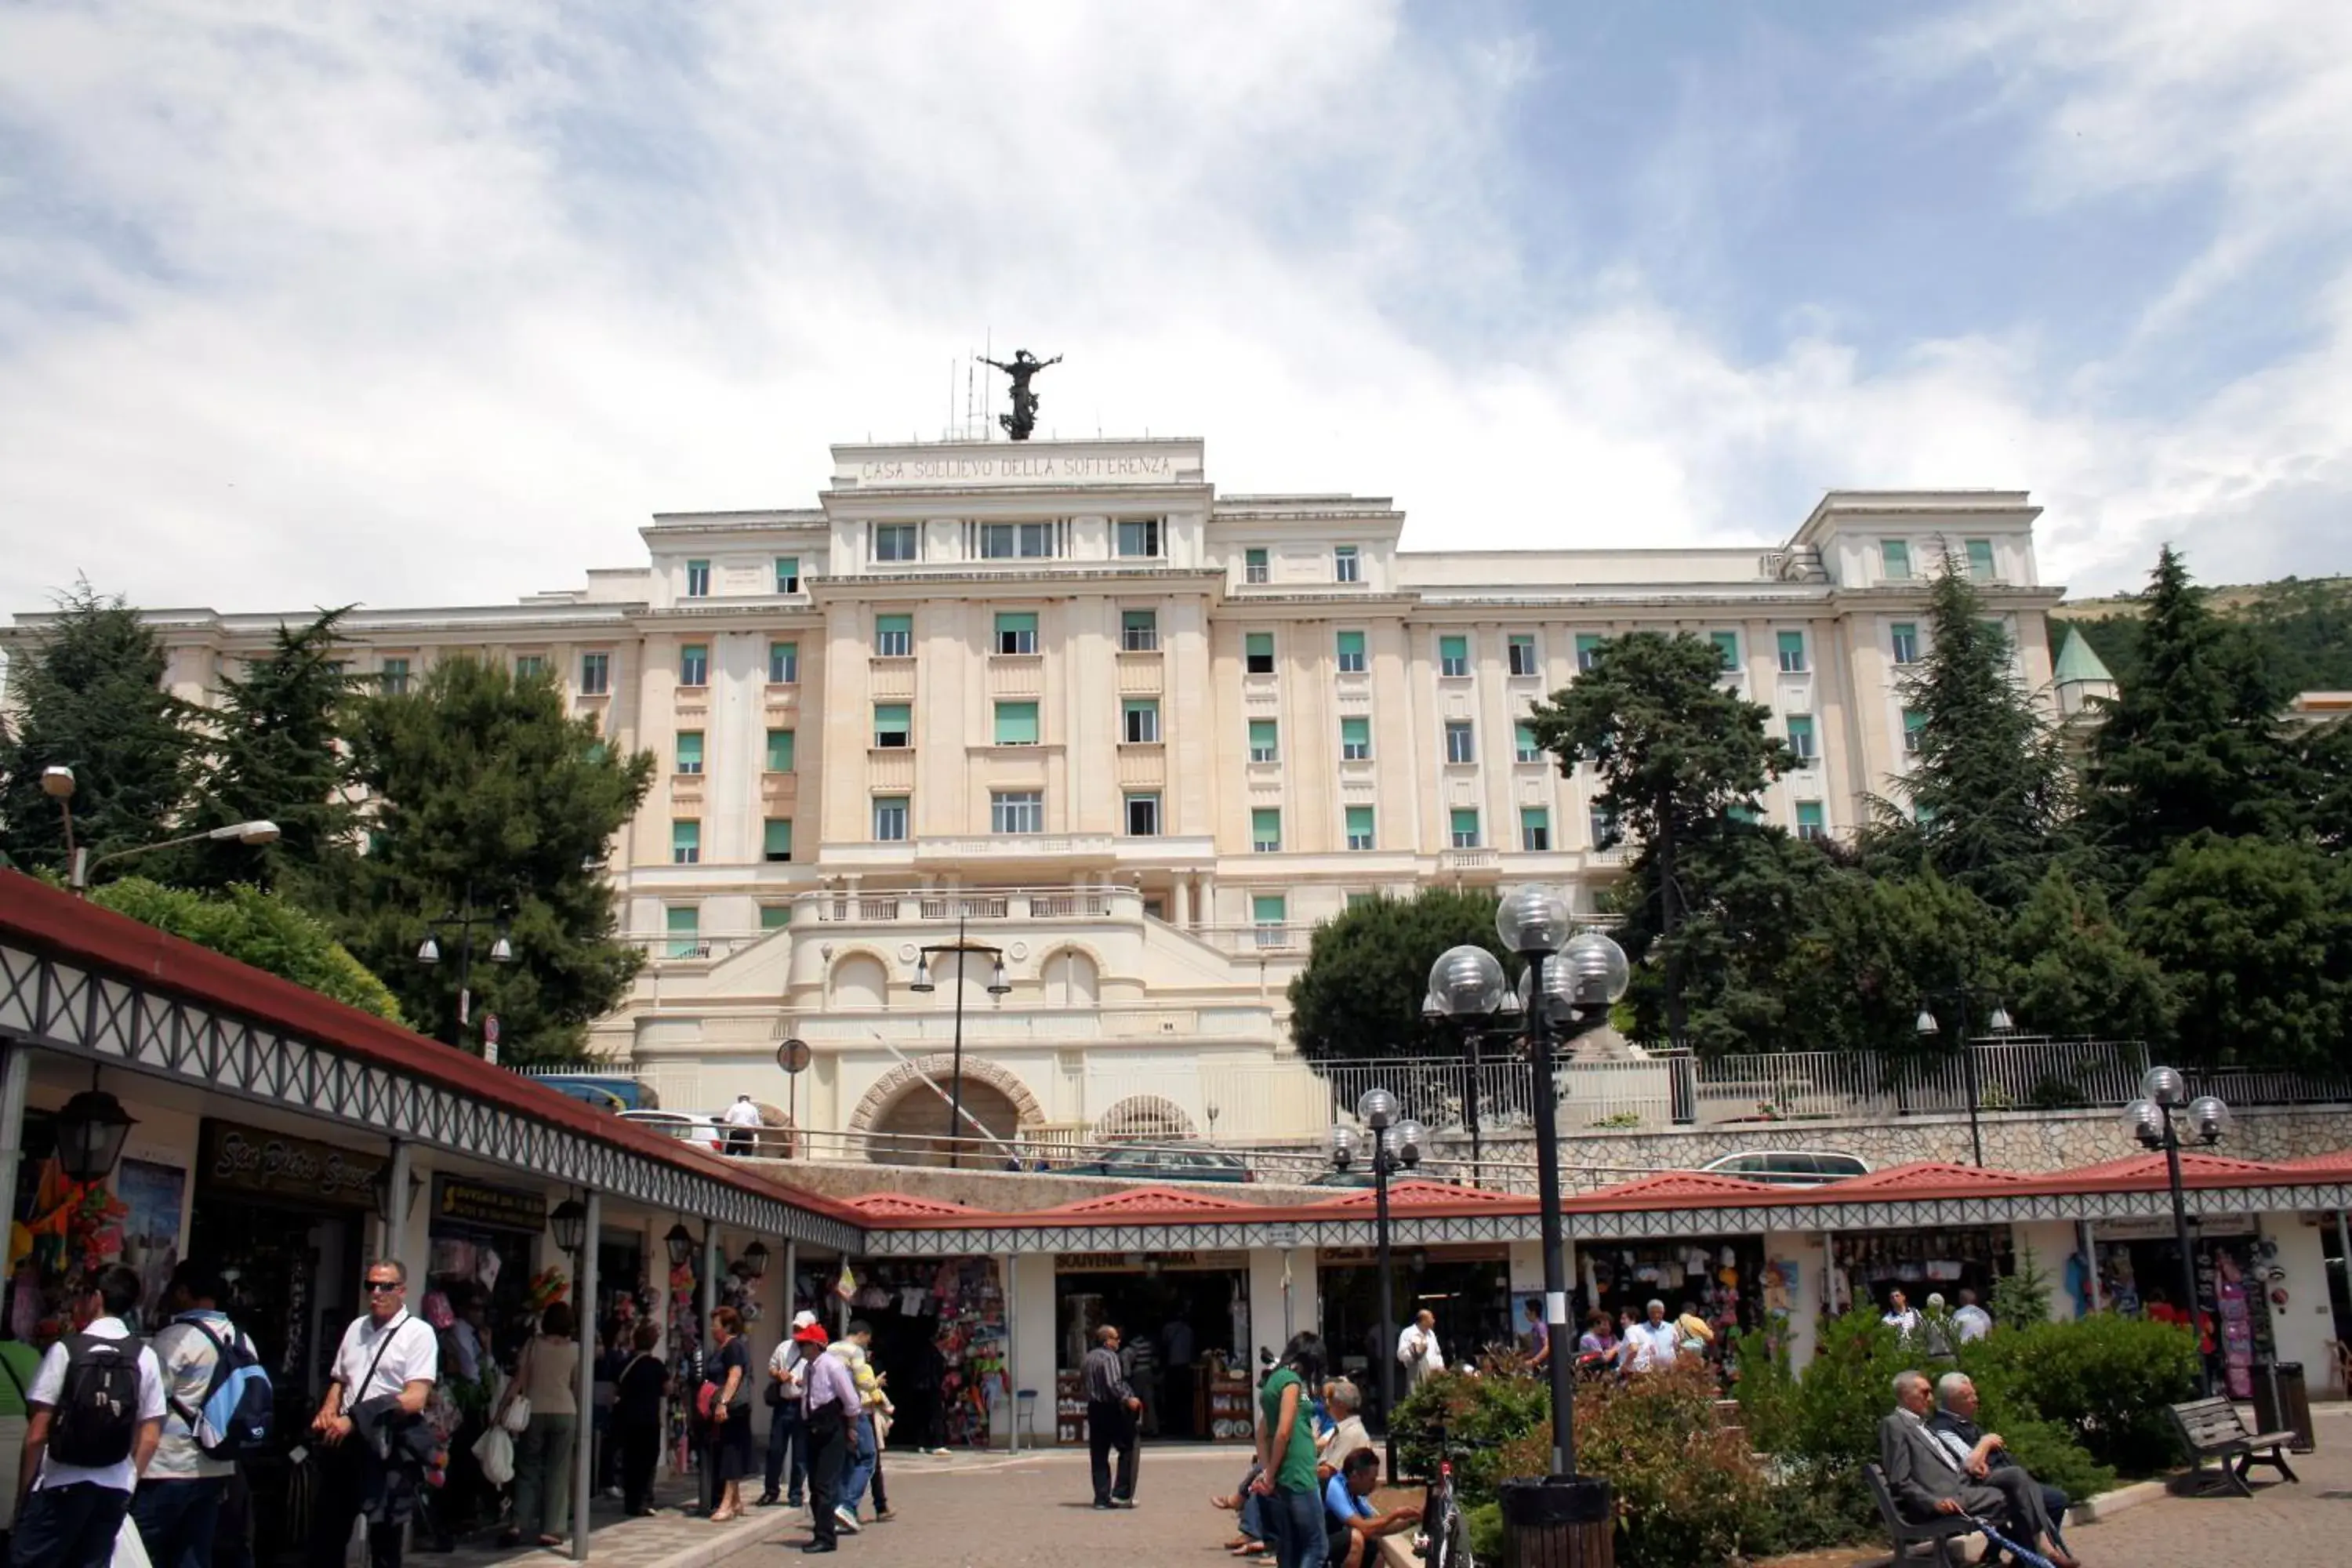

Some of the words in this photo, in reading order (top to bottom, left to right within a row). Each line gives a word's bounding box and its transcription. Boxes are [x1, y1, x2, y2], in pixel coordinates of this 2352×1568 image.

[862, 461, 905, 479] CASA
[913, 459, 993, 477] SOLLIEVO
[1001, 457, 1054, 477] DELLA
[1065, 456, 1171, 476] SOFFERENZA
